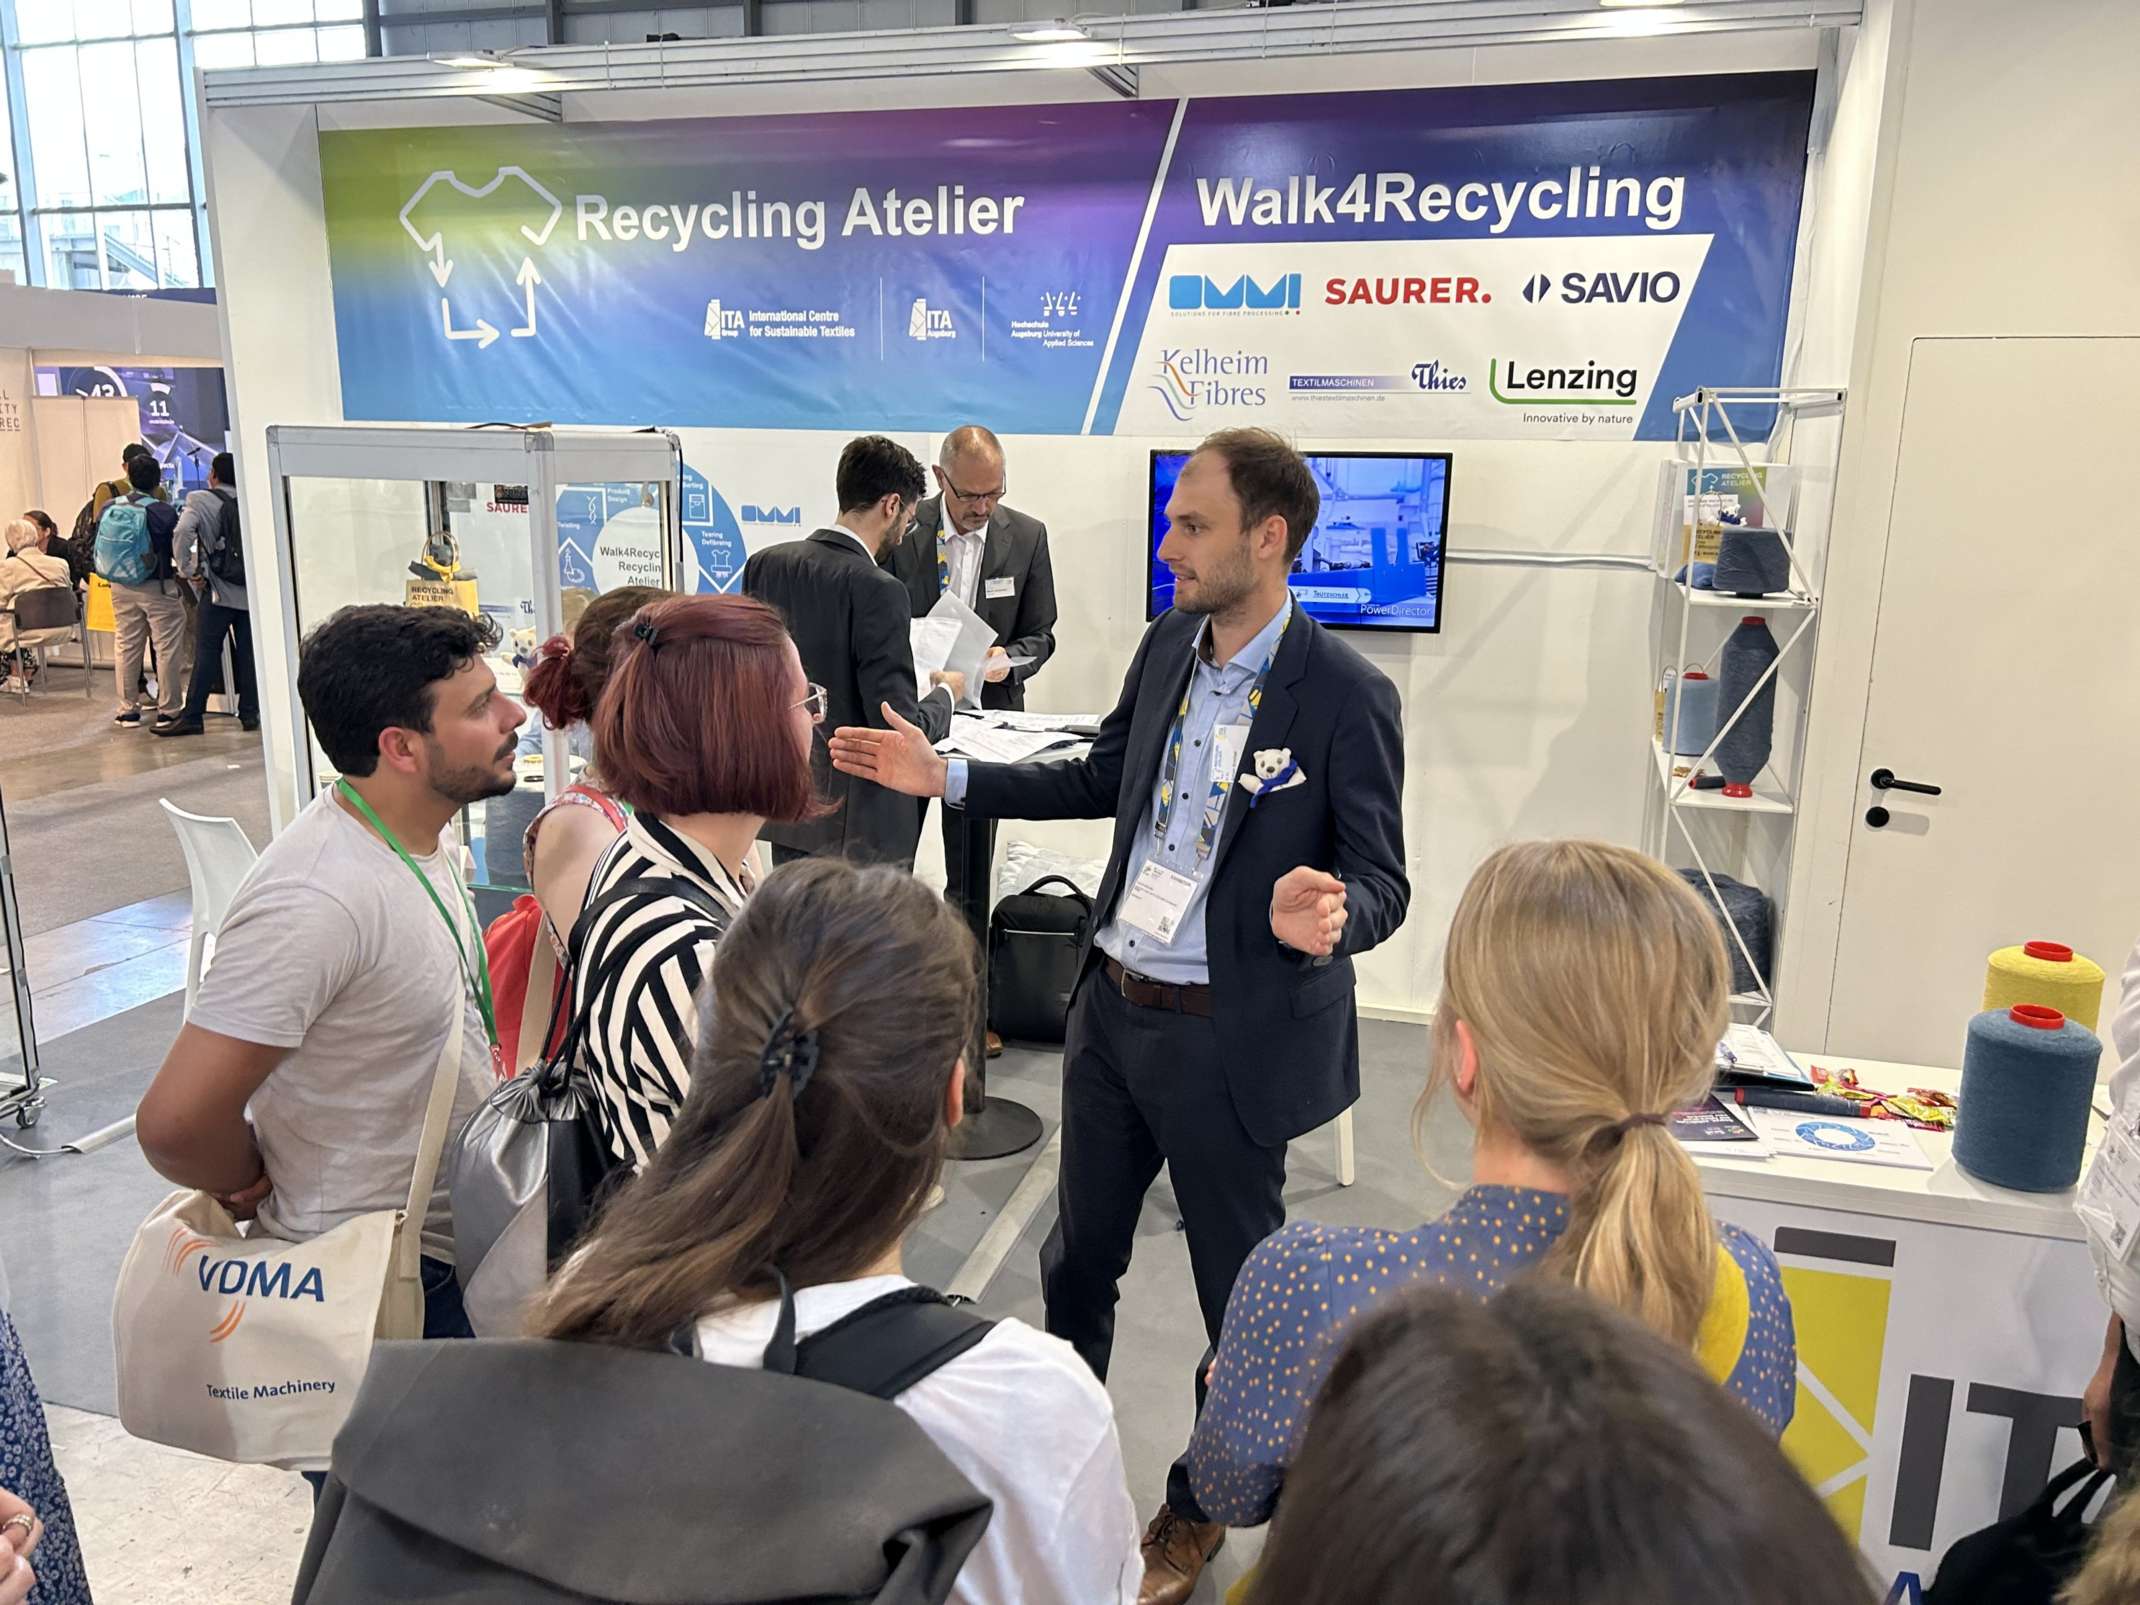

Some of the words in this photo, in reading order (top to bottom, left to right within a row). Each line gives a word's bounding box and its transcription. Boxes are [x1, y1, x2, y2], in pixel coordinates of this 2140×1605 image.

[1197, 166, 1687, 234] Walk4Recycling
[576, 190, 828, 251] Recycling
[842, 186, 1025, 239] Atelier
[1324, 275, 1492, 305] SAURER.
[1561, 271, 1681, 304] SAVIO
[721, 310, 745, 329] ITA
[749, 310, 807, 322] International
[808, 310, 840, 322] Centre
[926, 310, 952, 329] ITA
[1011, 320, 1049, 329] Hochschule
[749, 326, 763, 337] for
[764, 325, 818, 338] Sustainable
[820, 325, 856, 338] Textiles
[926, 329, 957, 338] Augsburg
[1011, 329, 1042, 339] Augsburg
[1043, 329, 1072, 338] University
[1073, 329, 1081, 337] of
[1042, 338, 1066, 348] Applied
[1067, 339, 1094, 347] Sciences
[1161, 348, 1269, 375] Kelheim
[1291, 377, 1375, 387] TEXTILMASCHINEN
[1411, 359, 1467, 390] Thies
[1507, 360, 1638, 398] Lenzing
[1188, 380, 1267, 407] Fibres
[150, 400, 170, 417] 11
[1523, 412, 1579, 424] Innovative
[1581, 412, 1594, 425] by
[1598, 414, 1633, 424] nature
[627, 575, 661, 586] Atelier
[411, 586, 454, 595] RECYCLING
[412, 594, 444, 602] ATELIER
[1360, 604, 1432, 616] PowerDirector
[199, 1255, 326, 1303] VDMA
[206, 1383, 249, 1400] Textile
[253, 1379, 336, 1399] Machinery
